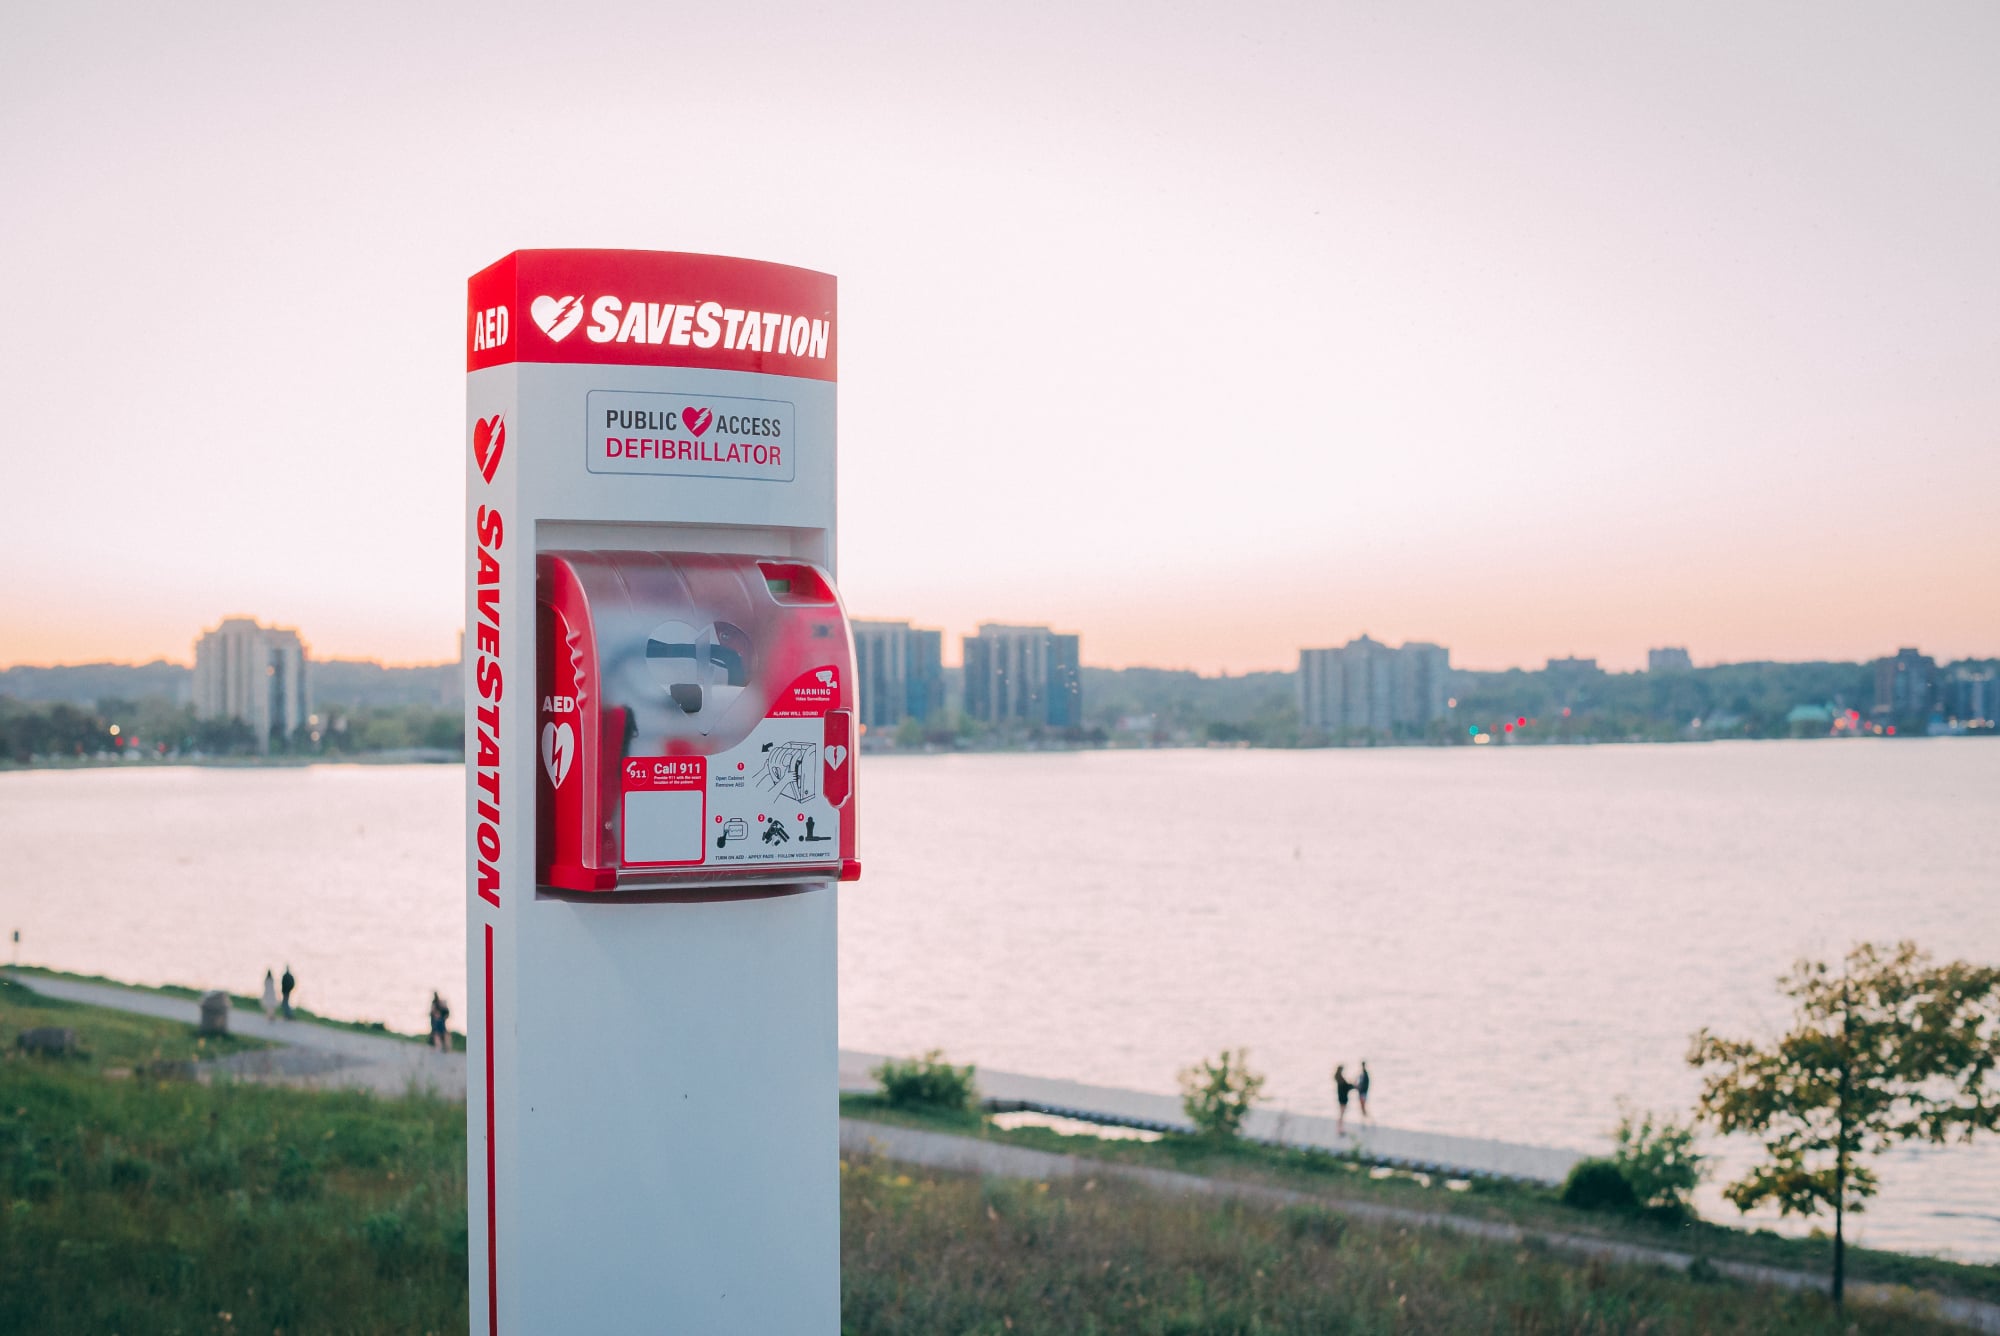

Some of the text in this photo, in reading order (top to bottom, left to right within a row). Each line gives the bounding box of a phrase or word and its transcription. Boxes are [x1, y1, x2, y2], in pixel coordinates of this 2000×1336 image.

[474, 305, 509, 351] AED
[606, 409, 781, 437] PUBLIC ACCESS
[606, 437, 781, 466] DEFIBRILLATOR
[793, 688, 831, 696] WARNING
[542, 695, 575, 713] AED
[630, 769, 647, 779] 911
[653, 762, 701, 775] Call 911
